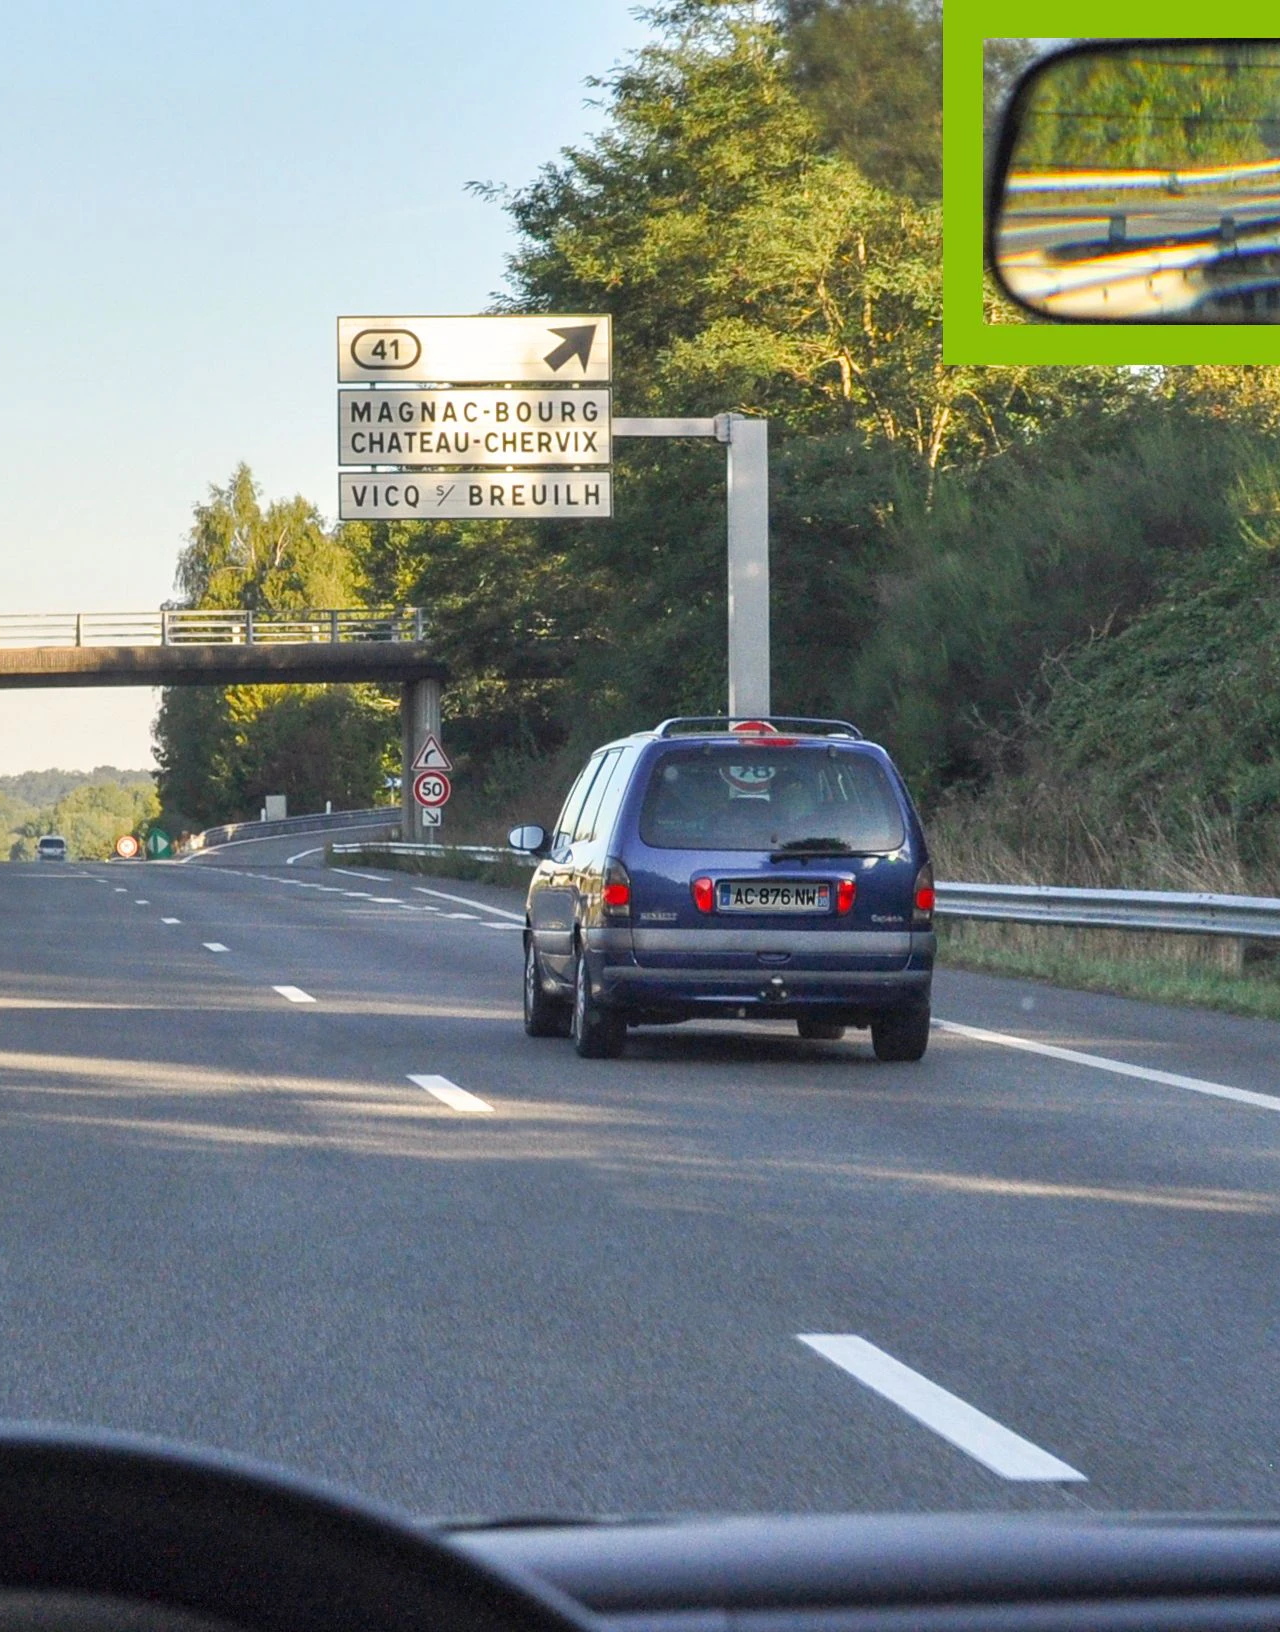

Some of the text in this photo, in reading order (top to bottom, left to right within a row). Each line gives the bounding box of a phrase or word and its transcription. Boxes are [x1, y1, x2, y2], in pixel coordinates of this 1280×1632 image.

[371, 339, 400, 360] 41
[350, 401, 599, 423] MAGNAC-BOURG
[350, 431, 598, 453] CHATEAU-CHERVIX
[351, 485, 420, 508] VICQ
[469, 484, 600, 506] BREUILH
[422, 782, 443, 796] 50
